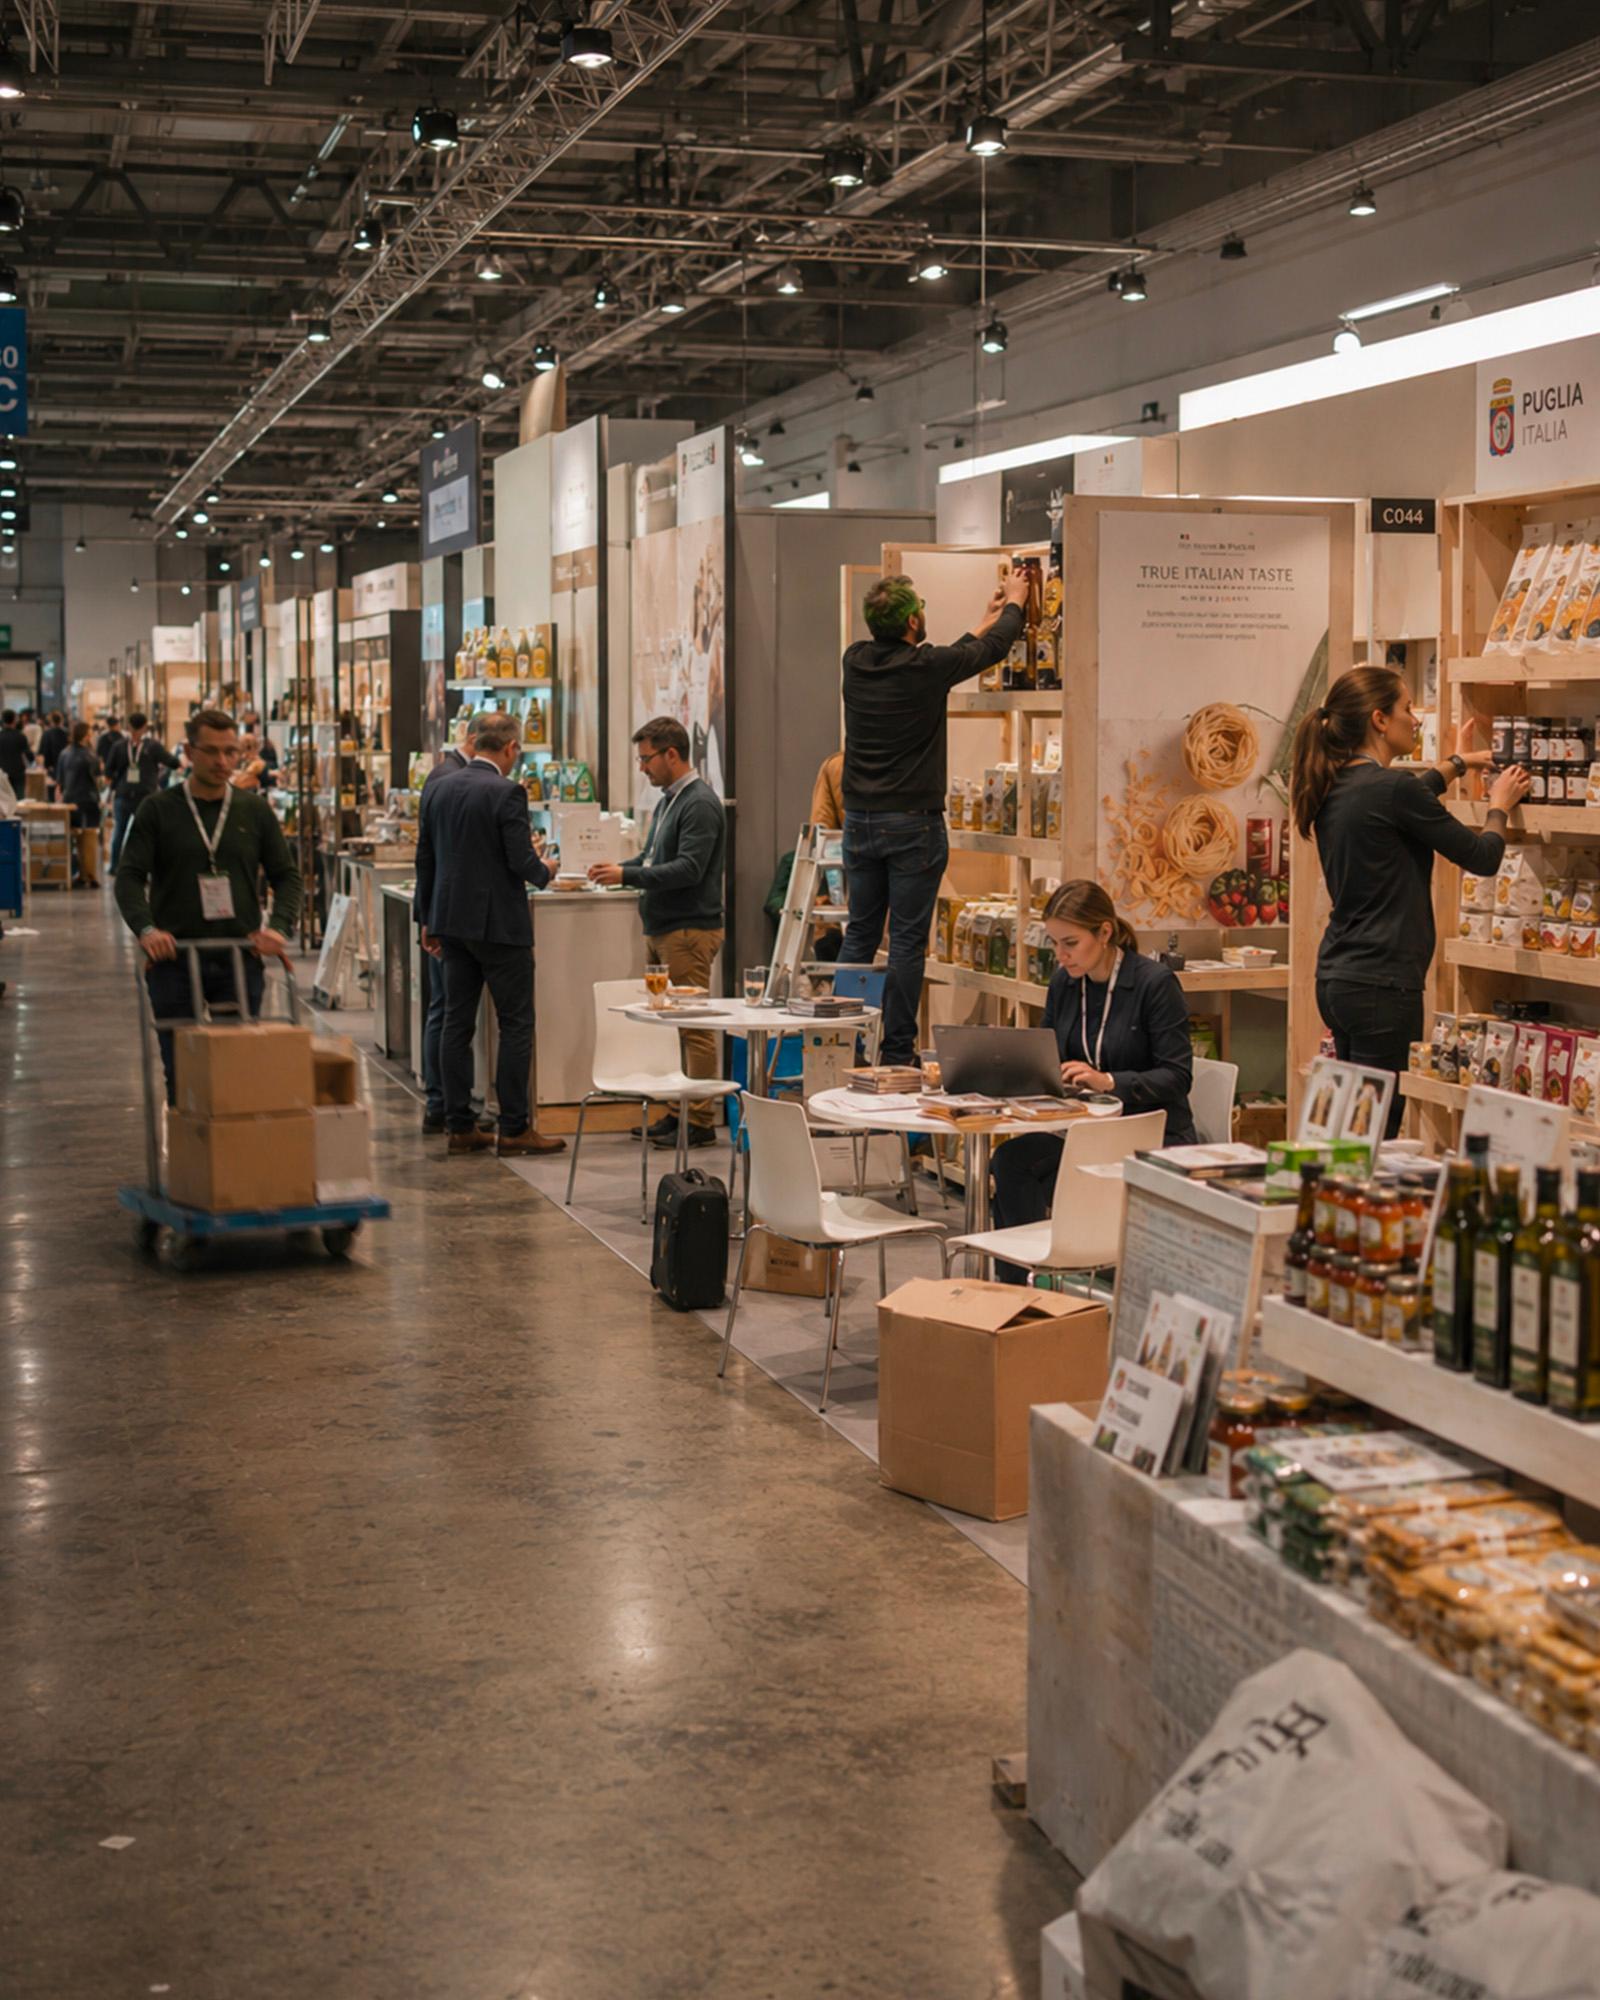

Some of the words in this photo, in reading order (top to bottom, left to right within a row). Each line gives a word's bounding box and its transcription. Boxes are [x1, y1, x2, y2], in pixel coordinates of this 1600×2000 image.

[0, 345, 18, 369] 0
[1522, 382, 1584, 416] PUGLIA
[1522, 419, 1568, 446] ITALIA
[1383, 507, 1424, 525] C044
[1140, 565, 1180, 580] TRUE
[1184, 566, 1244, 581] ITALIAN
[1249, 567, 1293, 582] TASTE
